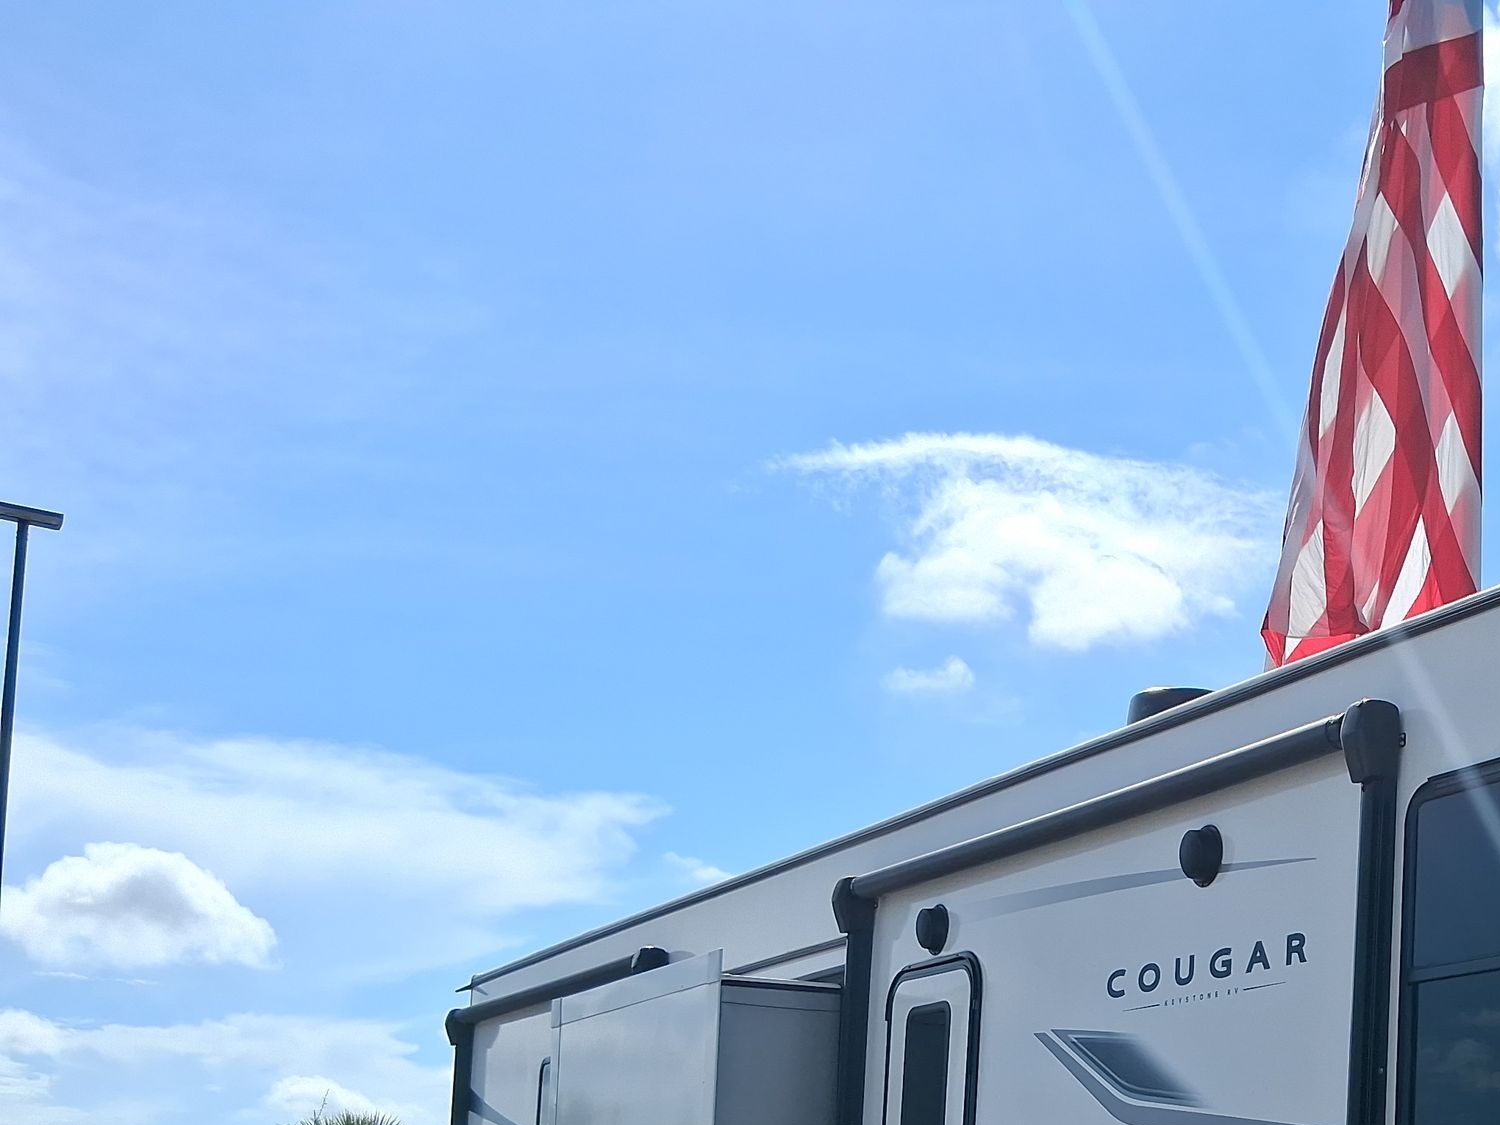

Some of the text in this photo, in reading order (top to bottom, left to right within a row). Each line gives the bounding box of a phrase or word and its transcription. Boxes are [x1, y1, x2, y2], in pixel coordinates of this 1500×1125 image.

[1106, 932, 1307, 998] COUGAR
[1164, 987, 1239, 1007] KEYSTONE RV
